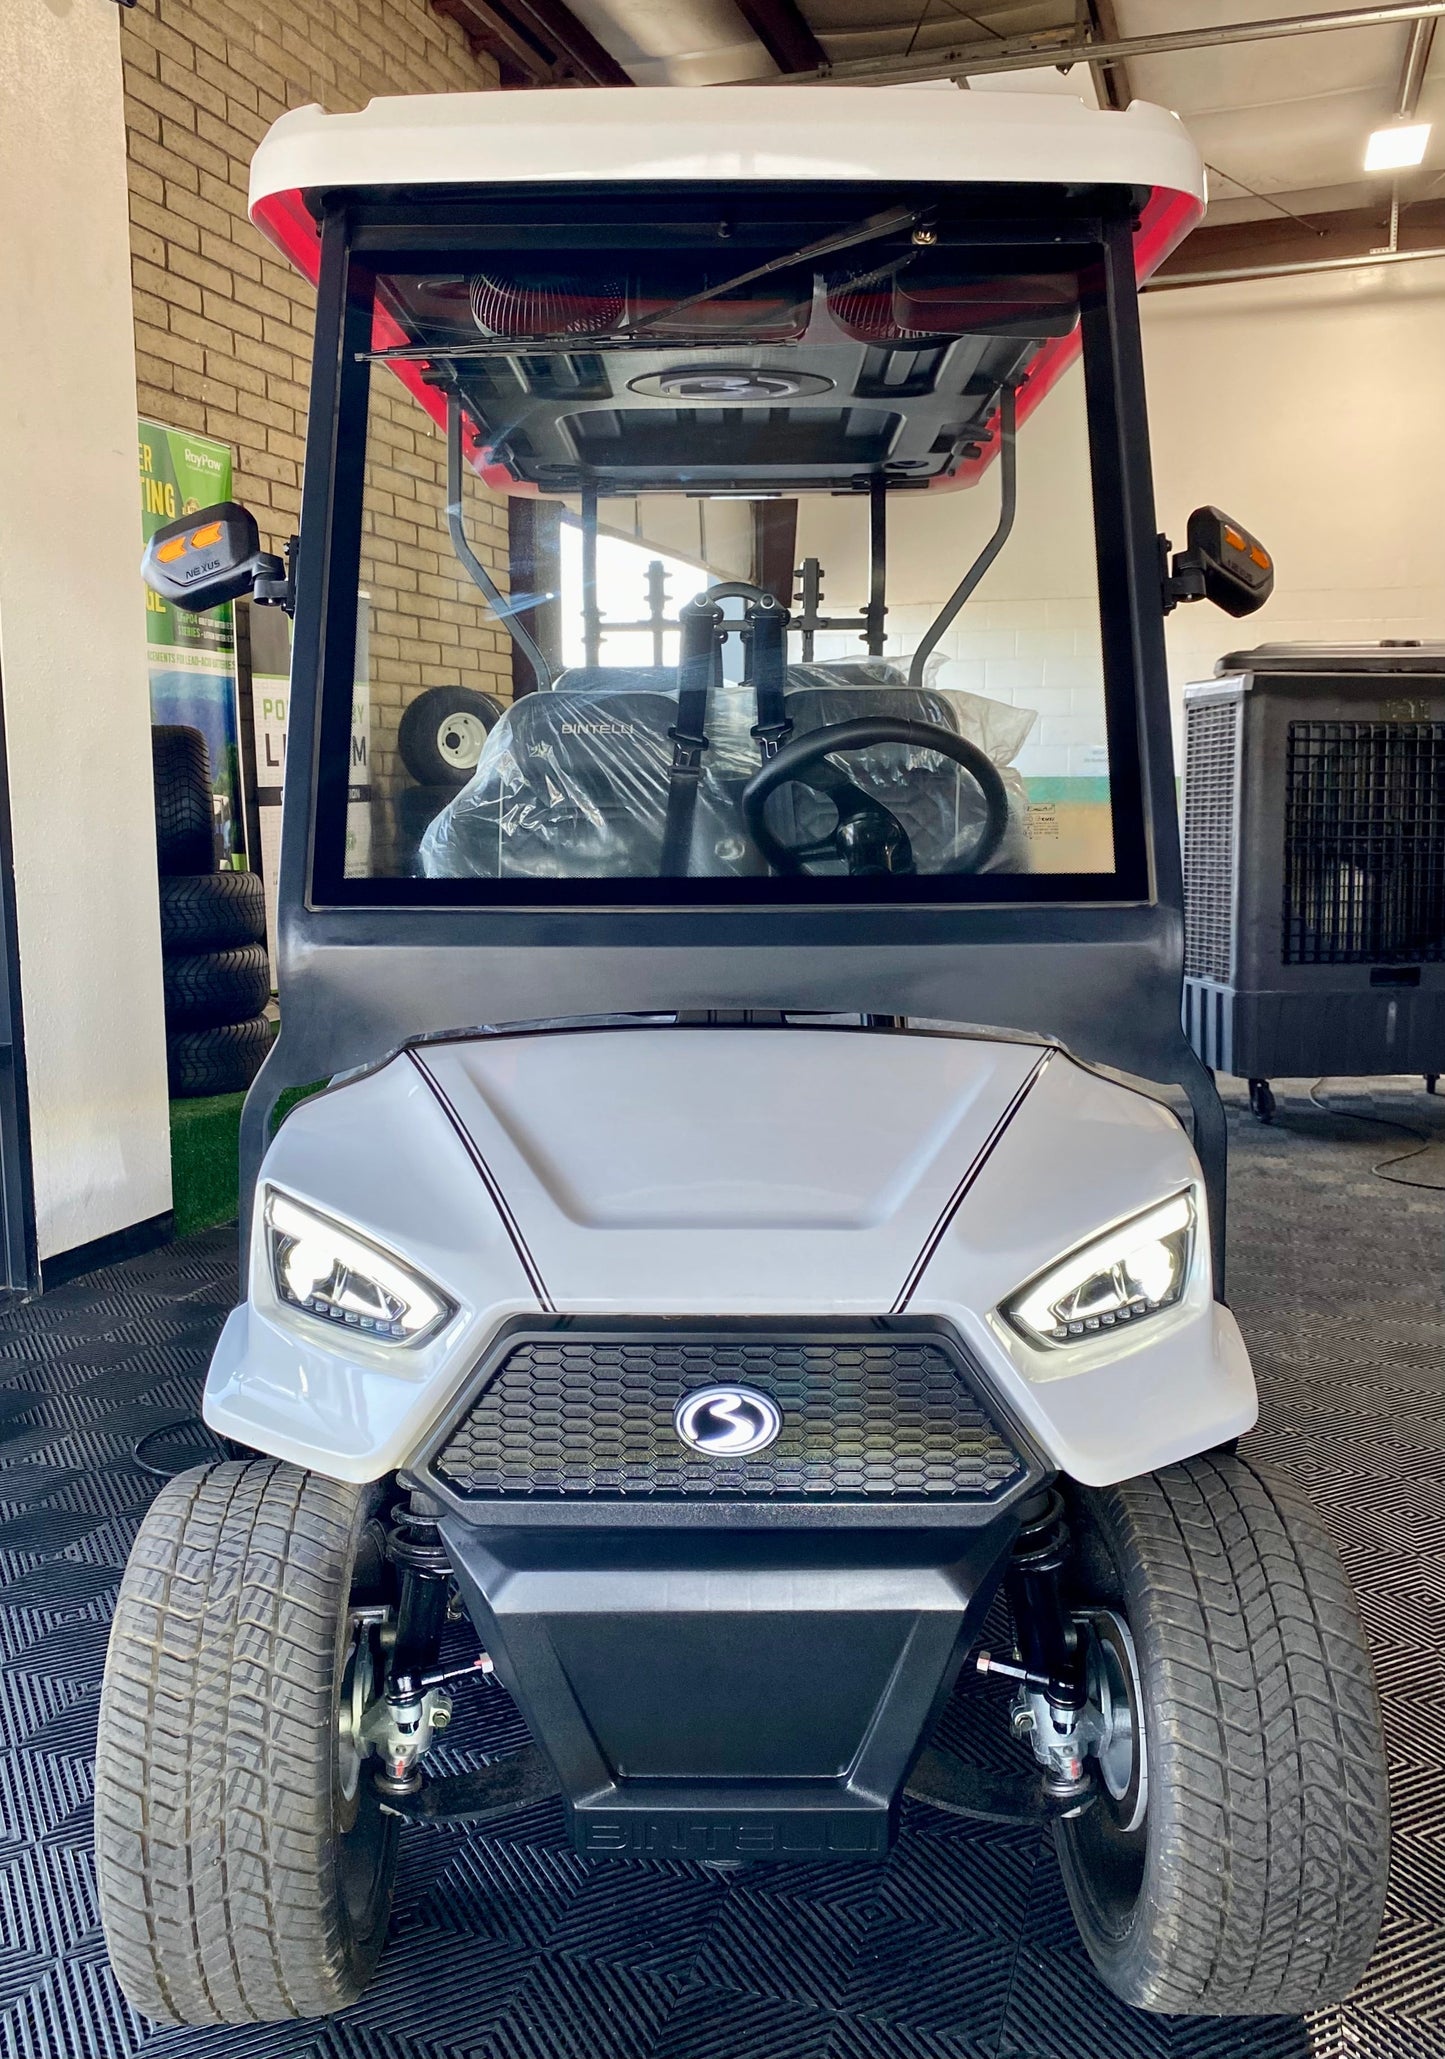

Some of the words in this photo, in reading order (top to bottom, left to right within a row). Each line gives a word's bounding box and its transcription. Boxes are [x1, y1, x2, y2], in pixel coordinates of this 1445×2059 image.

[185, 559, 221, 580] NEXUS
[263, 698, 288, 721] PO
[561, 723, 634, 735] BINTELLI
